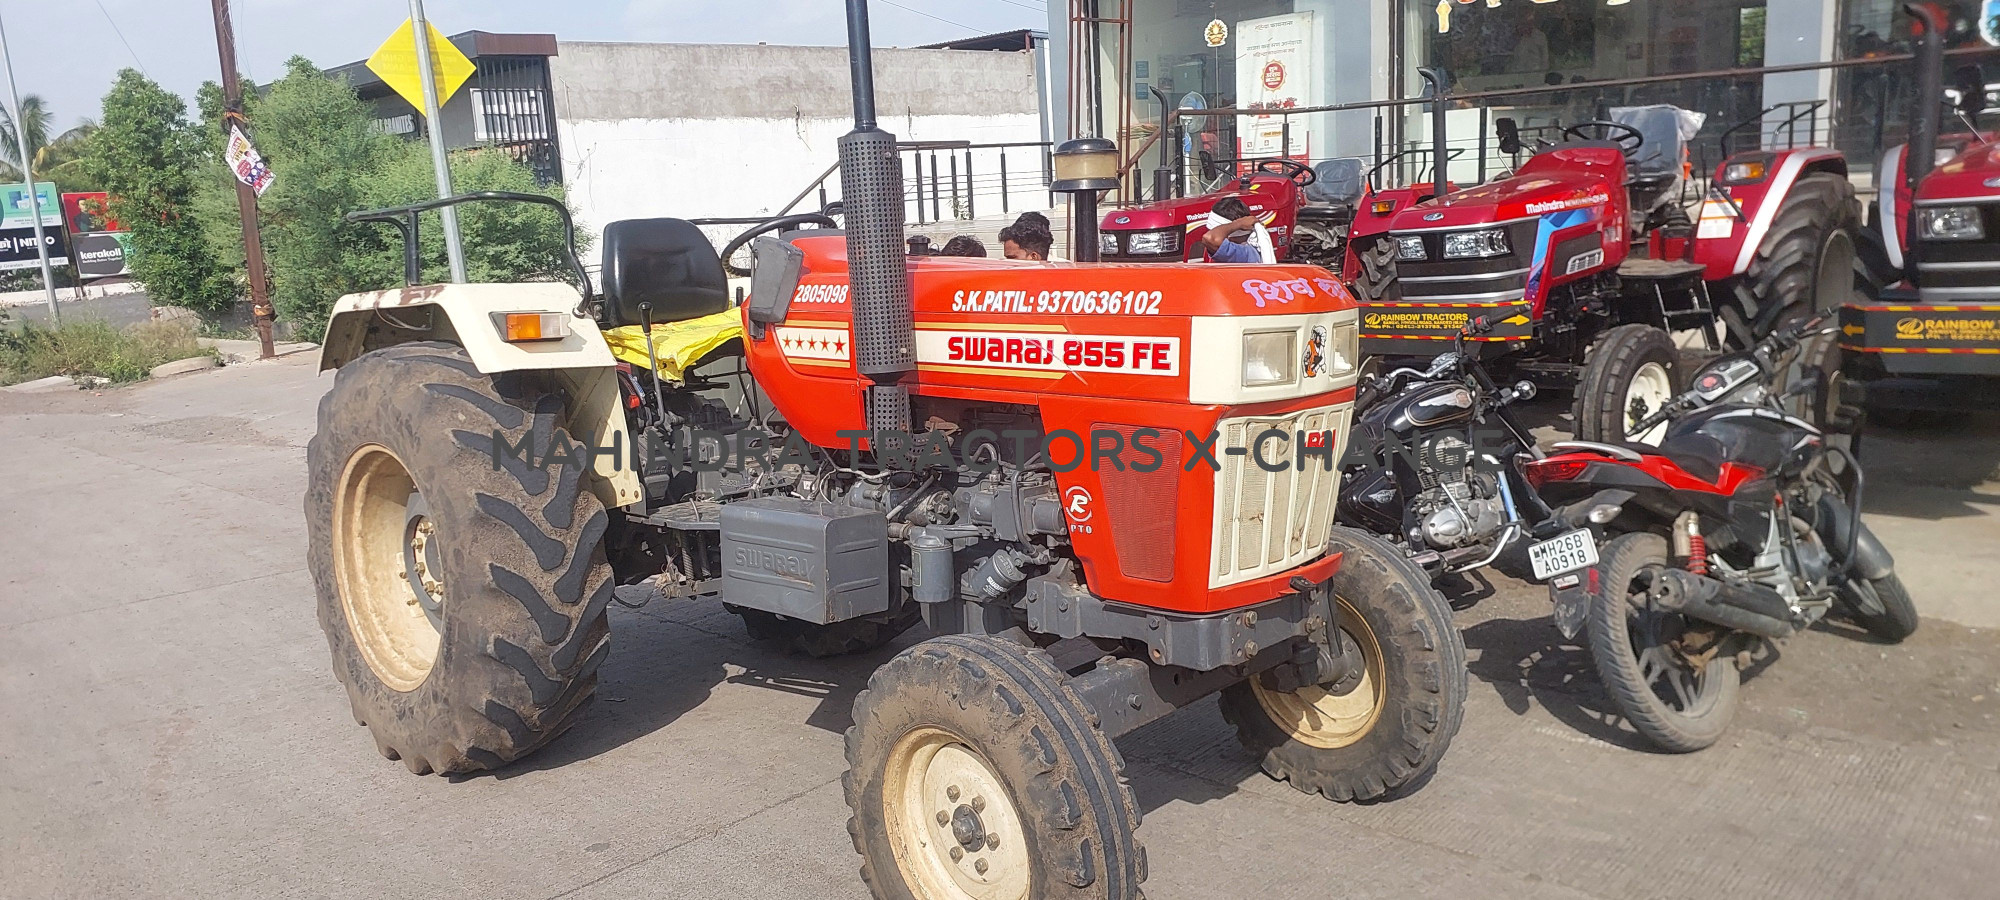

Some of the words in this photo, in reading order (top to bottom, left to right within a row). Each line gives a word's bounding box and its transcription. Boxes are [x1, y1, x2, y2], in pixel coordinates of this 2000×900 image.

[1525, 200, 1565, 214] Mahindra
[20, 236, 55, 247] NITO
[80, 248, 122, 259] kerakoll
[793, 284, 849, 304] 2805098
[952, 290, 1034, 313] S.K.PATIL:
[1036, 290, 1163, 315] 9370636102
[1421, 313, 1468, 321] TRACTORS
[1925, 320, 1995, 329] RAINBOW
[1063, 339, 1125, 368] 855
[1132, 341, 1172, 370] FE
[1070, 524, 1093, 534] PTO
[1544, 549, 1588, 575] A0918
